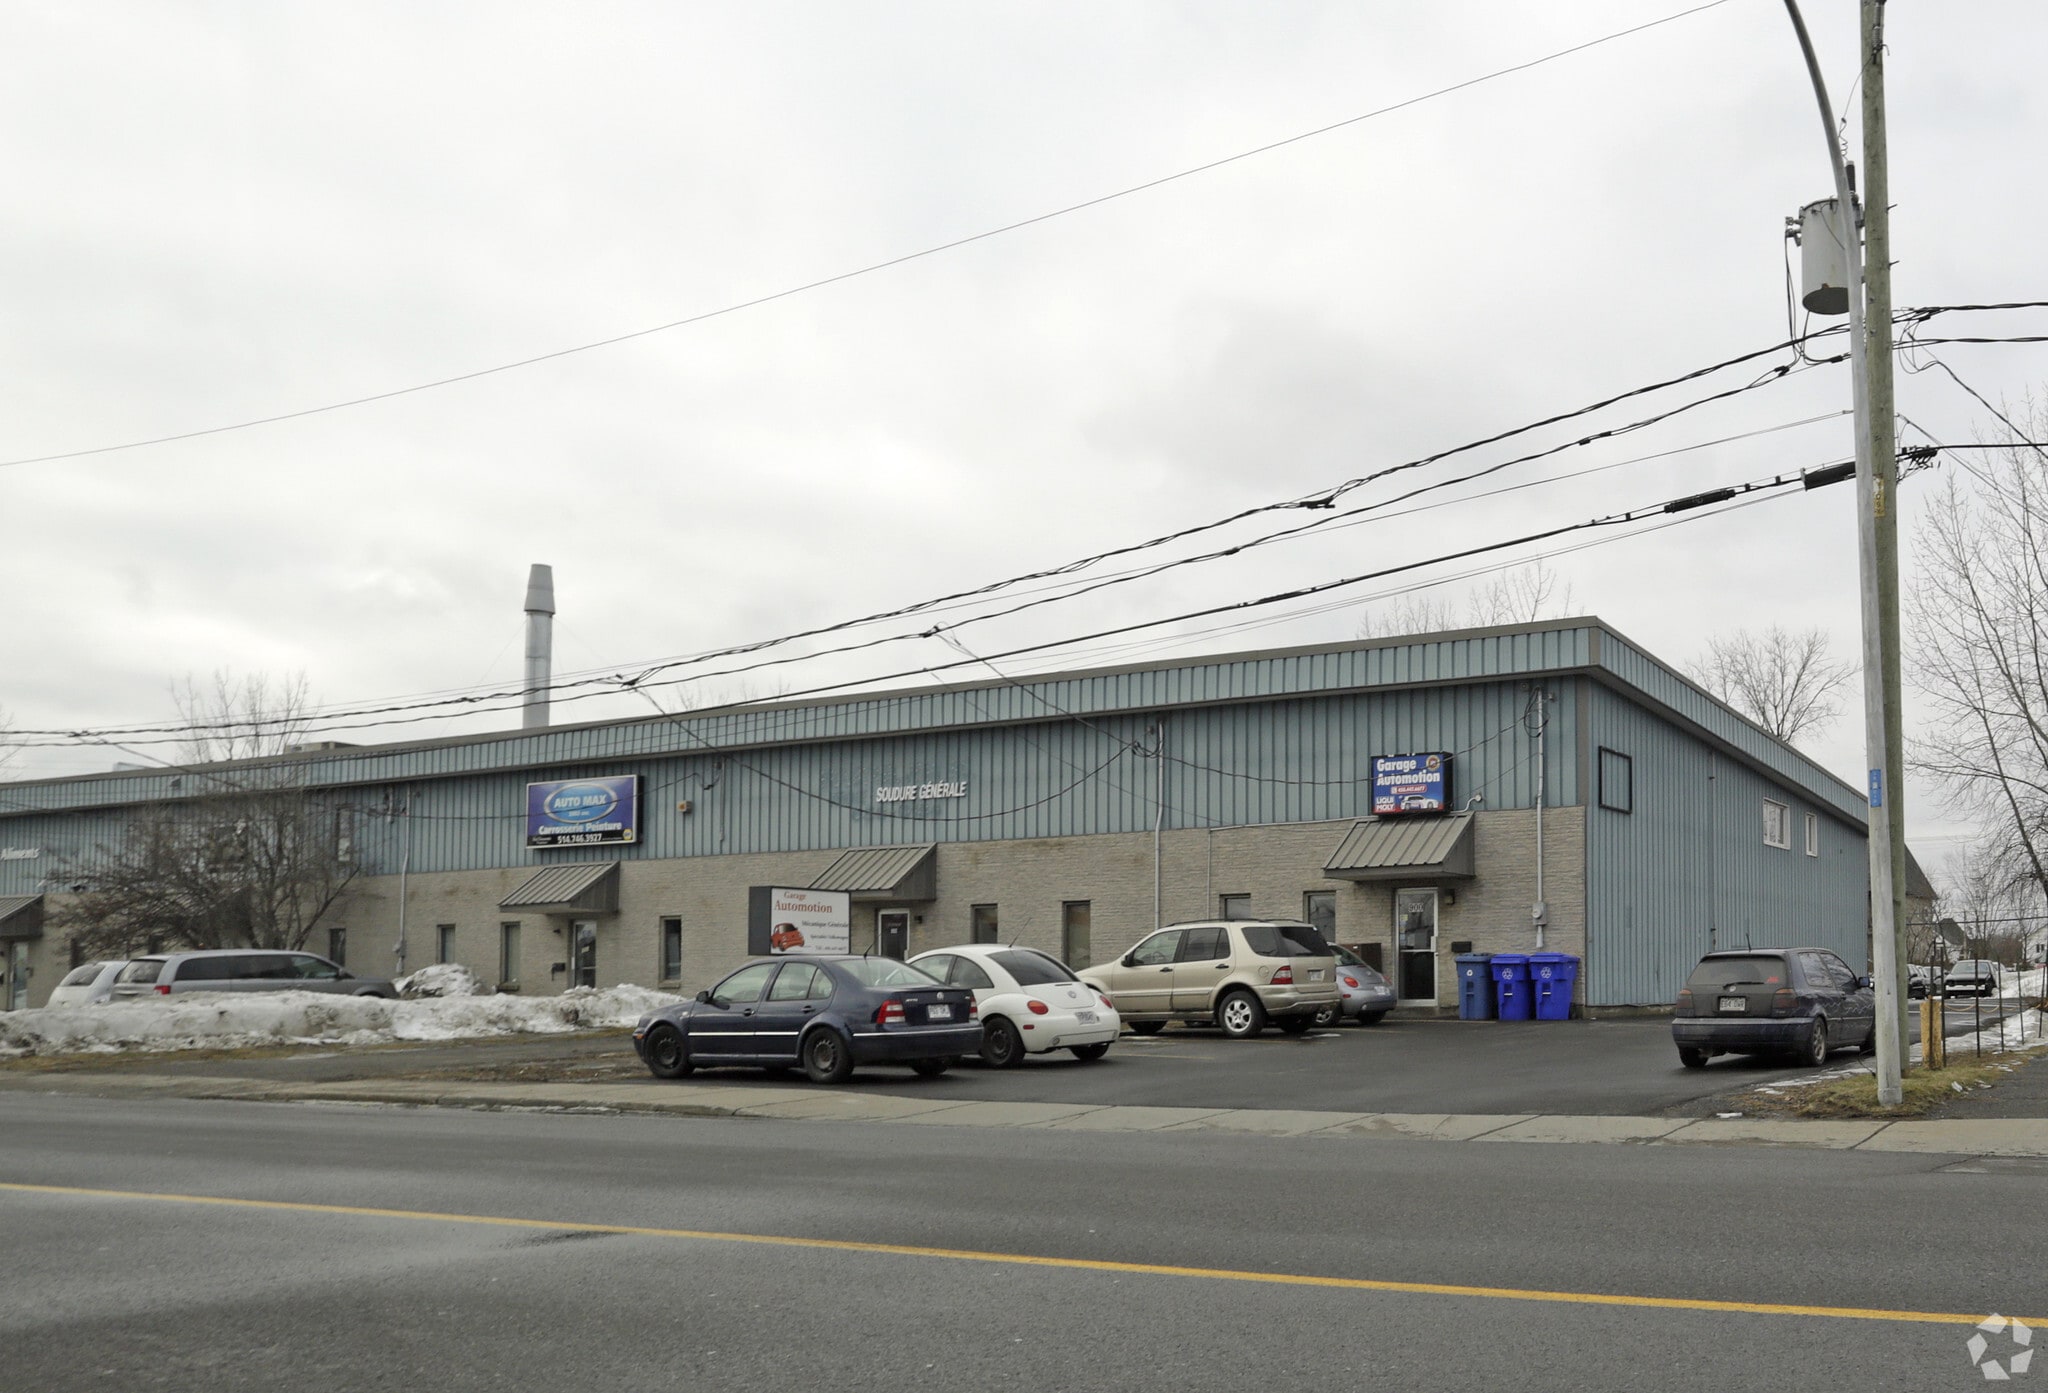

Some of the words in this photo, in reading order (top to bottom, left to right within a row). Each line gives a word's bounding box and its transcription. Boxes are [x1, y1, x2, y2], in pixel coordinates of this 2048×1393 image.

[1376, 758, 1416, 772] Garage
[1376, 770, 1441, 786] Automotion
[876, 785, 917, 802] SOUDURE
[919, 779, 967, 799] GÉNÉRALE
[554, 797, 581, 809] AUTO
[582, 794, 607, 806] MAX
[1375, 803, 1395, 812] MOLY
[538, 822, 584, 834] Carrosserie
[586, 821, 622, 832] Peinture
[784, 891, 807, 901] Garage
[775, 900, 833, 913] Automotion
